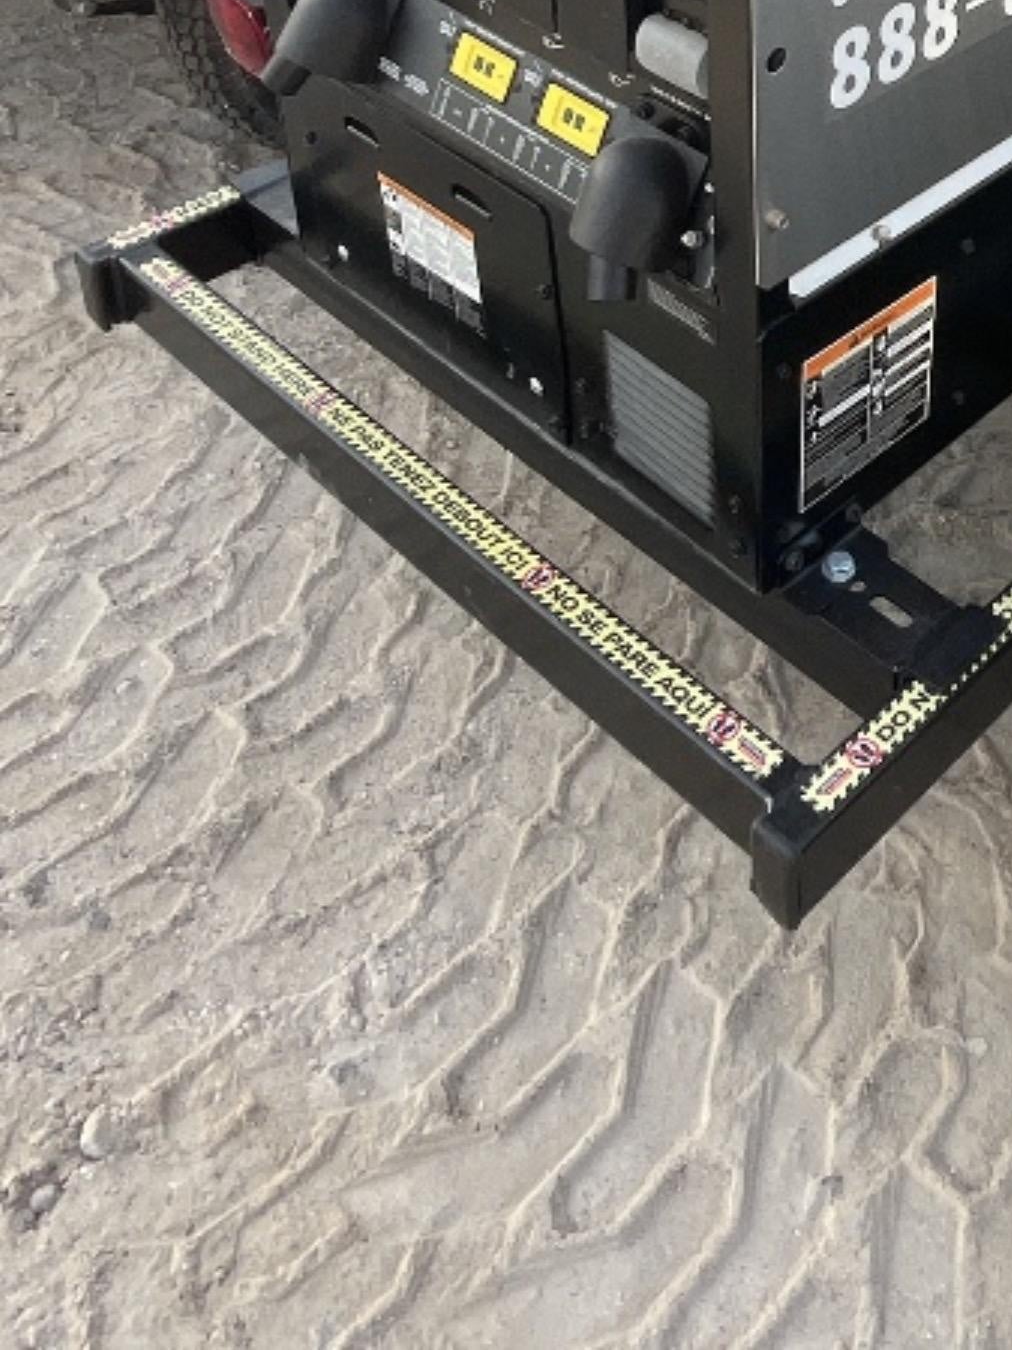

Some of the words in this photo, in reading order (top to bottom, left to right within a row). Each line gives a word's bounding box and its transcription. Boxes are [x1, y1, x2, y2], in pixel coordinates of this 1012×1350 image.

[383, 448, 436, 492] TENEZ
[431, 489, 504, 547] DEBOUT
[500, 545, 530, 571] ICI
[545, 584, 579, 613] NO
[577, 609, 610, 635] SE
[602, 632, 659, 679] PARE
[876, 710, 912, 742] DO
